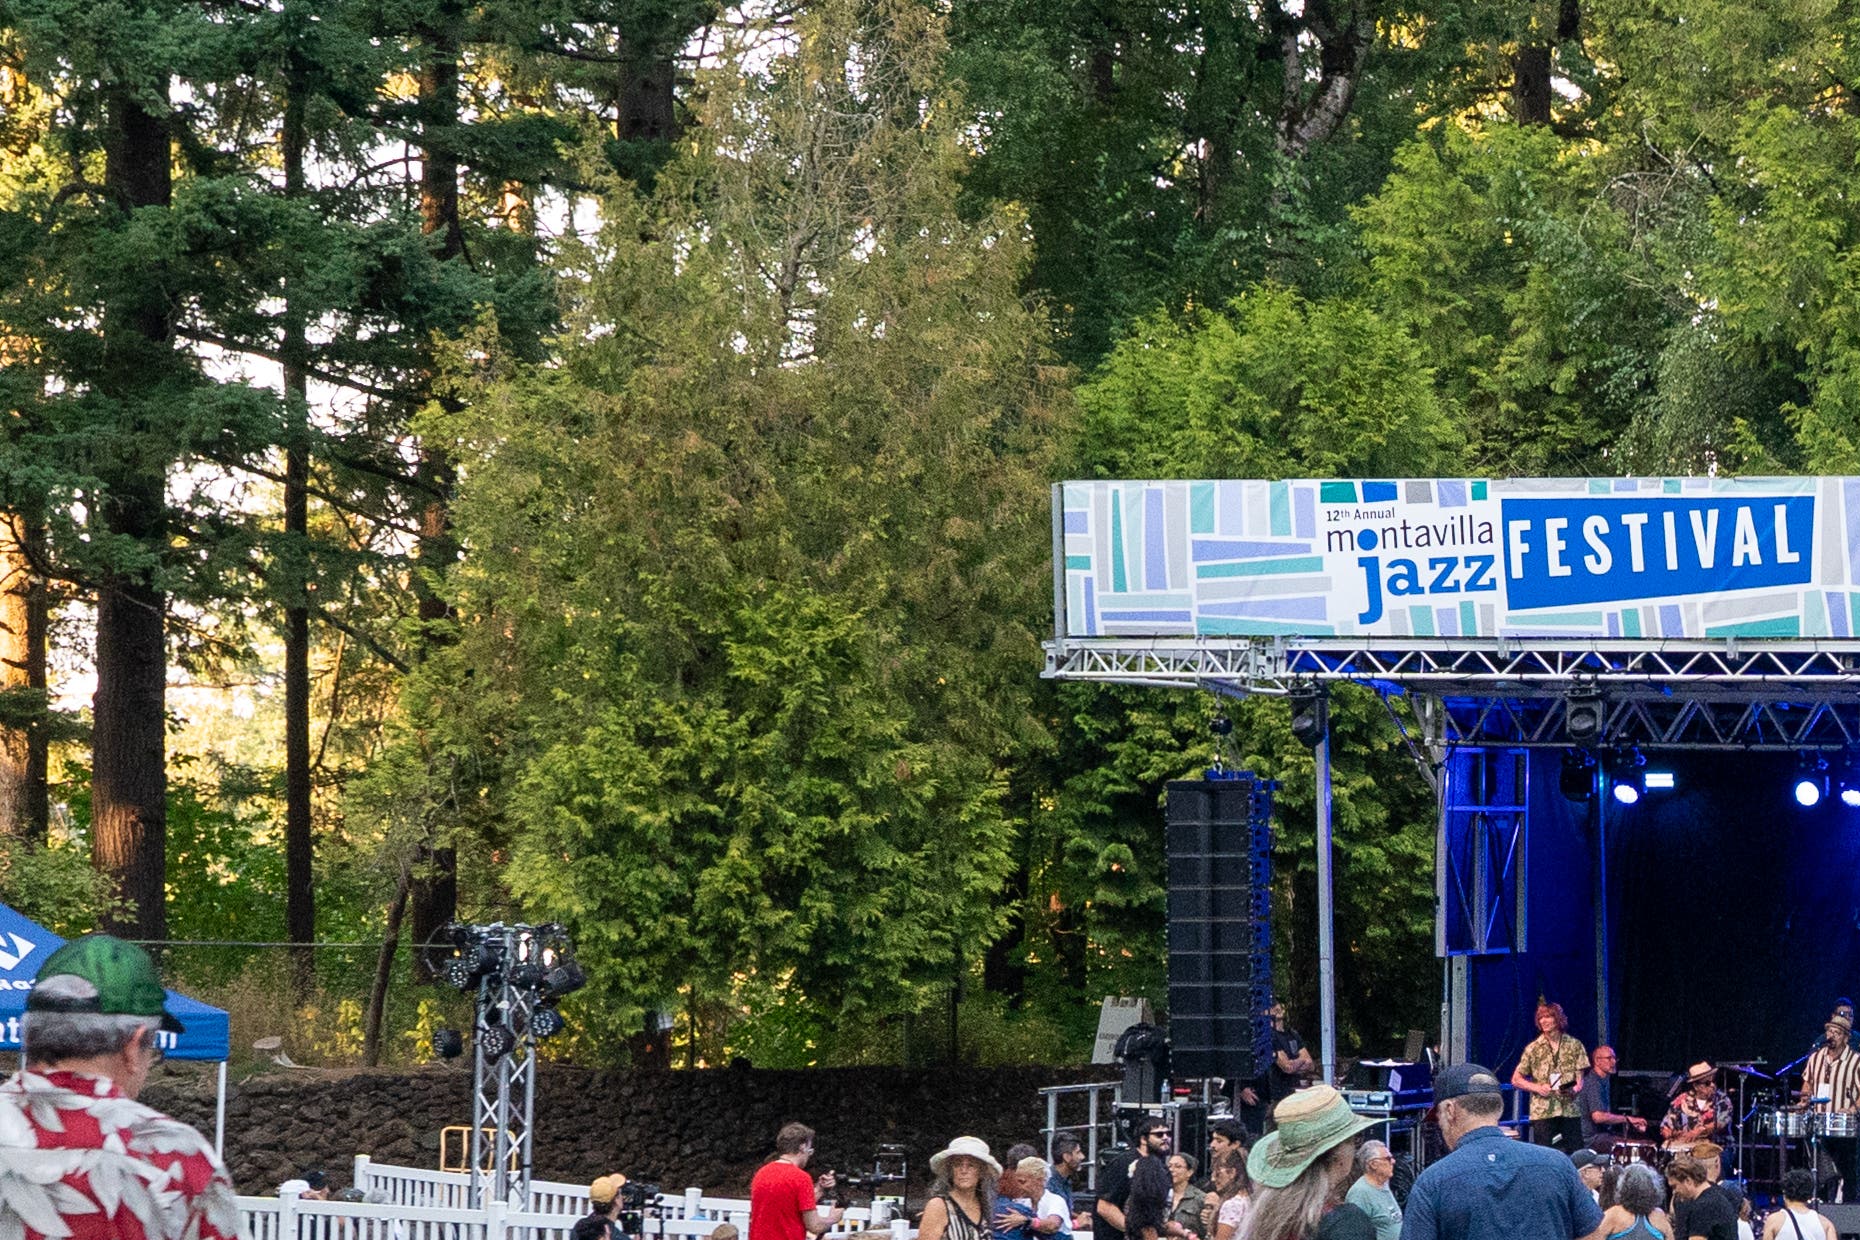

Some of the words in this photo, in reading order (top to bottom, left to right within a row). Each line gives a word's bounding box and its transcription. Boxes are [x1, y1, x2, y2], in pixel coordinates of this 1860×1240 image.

[1326, 509, 1350, 522] 12th
[1353, 507, 1396, 520] Annual
[1327, 514, 1494, 552] montavilla
[1508, 504, 1800, 579] FESTIVAL
[1357, 554, 1497, 625] jazz
